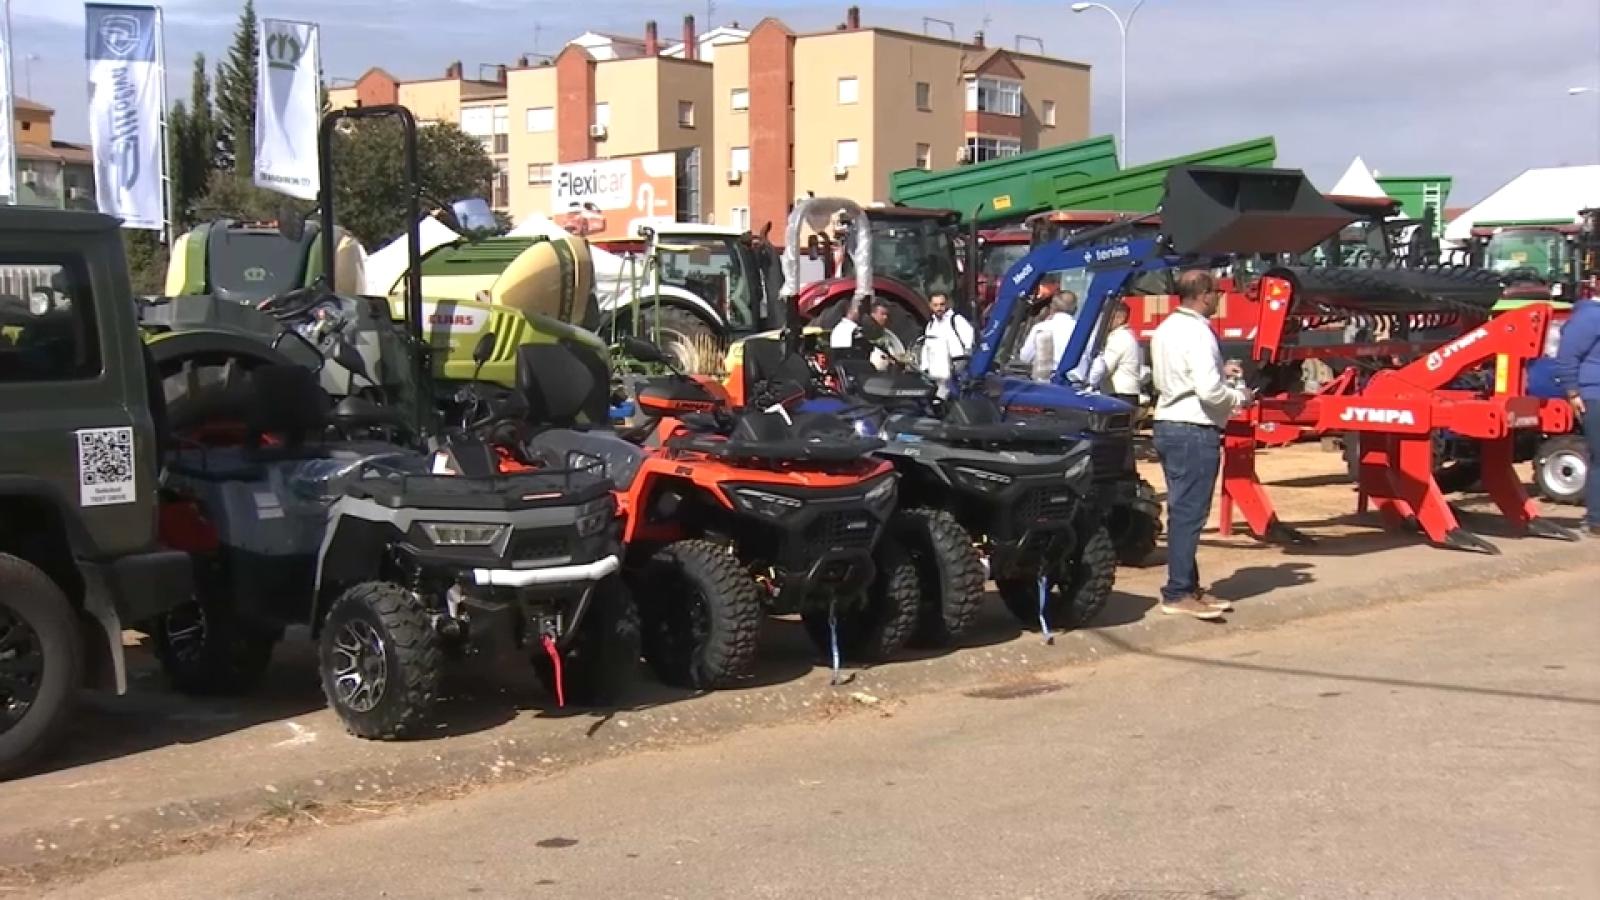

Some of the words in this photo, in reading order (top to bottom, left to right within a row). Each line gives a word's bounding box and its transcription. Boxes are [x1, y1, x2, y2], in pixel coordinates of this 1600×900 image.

[558, 168, 627, 197] Flexicar
[428, 314, 474, 325] CLAAS
[1443, 327, 1488, 358] JYMPA
[1340, 406, 1415, 426] JYMPA
